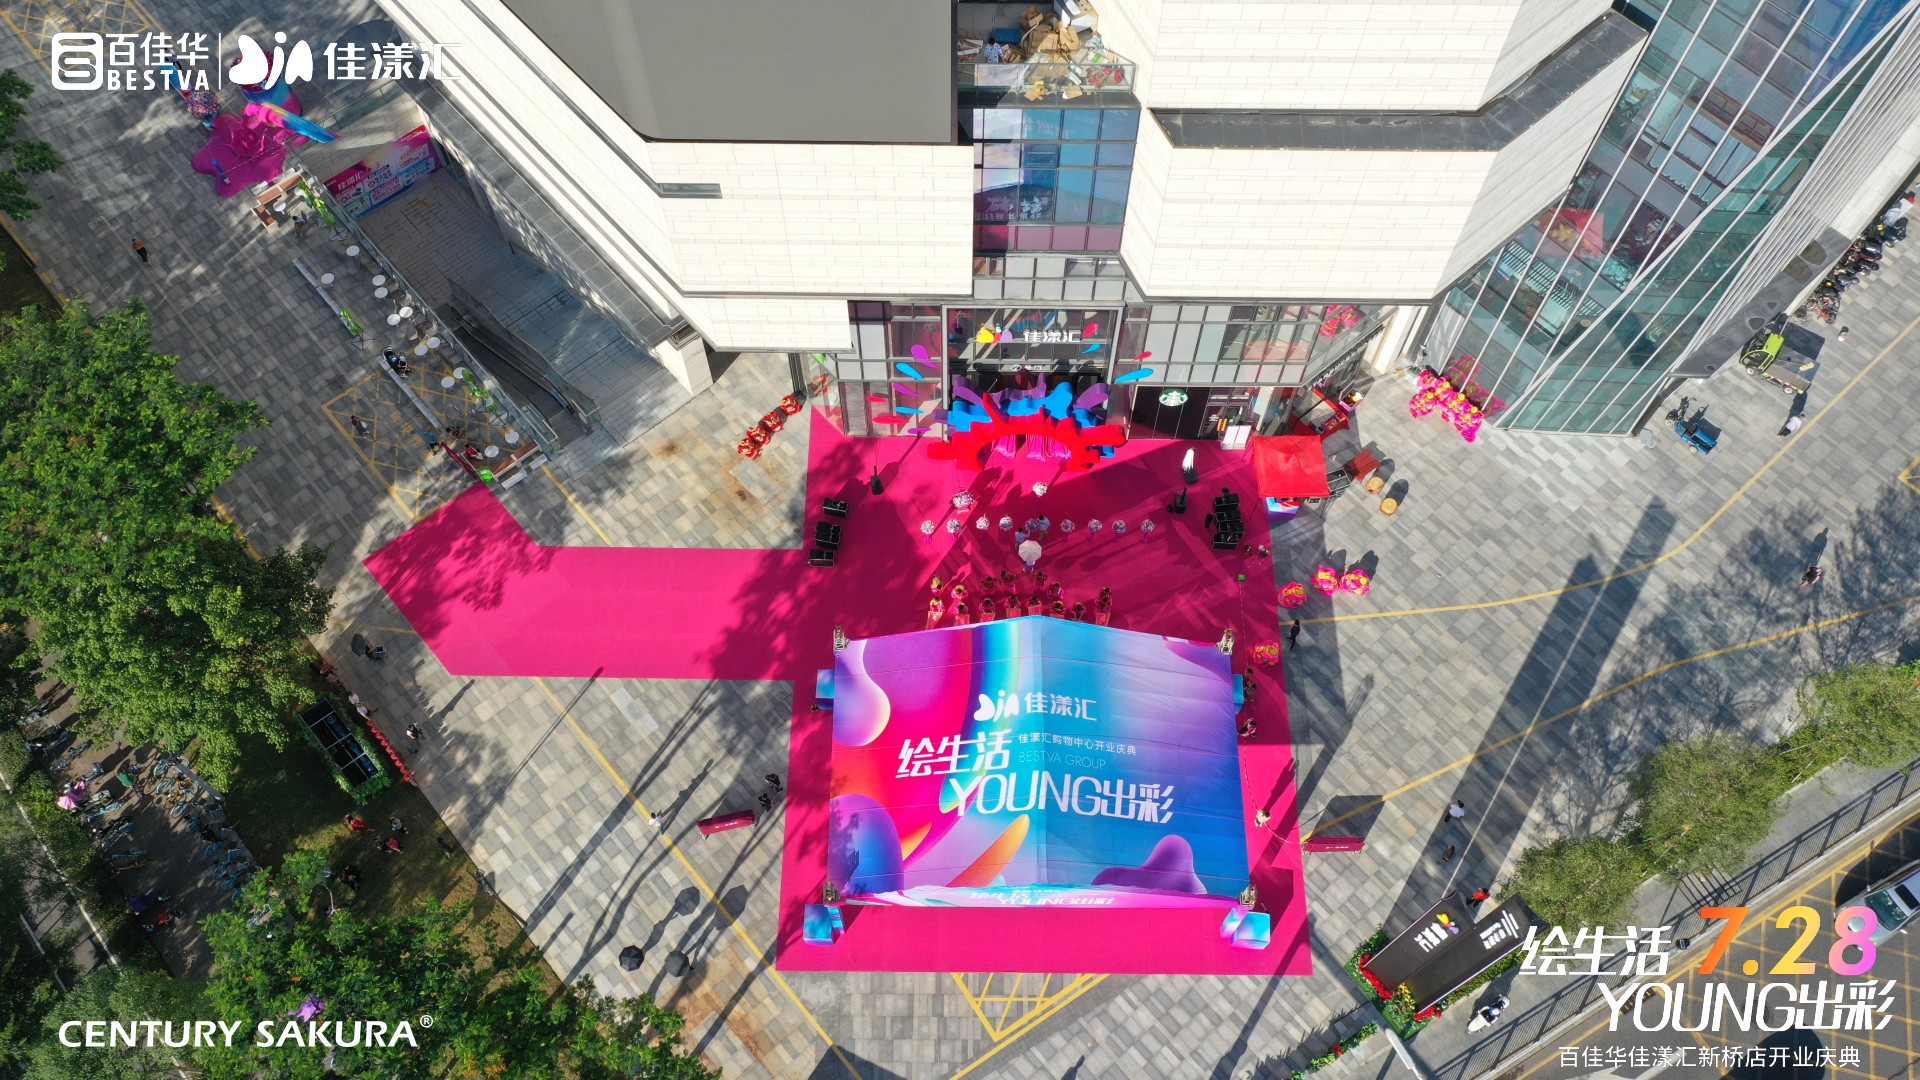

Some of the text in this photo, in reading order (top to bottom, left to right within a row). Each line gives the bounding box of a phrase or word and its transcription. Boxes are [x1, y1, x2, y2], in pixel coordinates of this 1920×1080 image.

[1023, 330, 1081, 342] 佳漾汇
[1024, 692, 1097, 721] 佳漾汇
[895, 729, 1012, 778] 绘生活
[1018, 732, 1137, 756] 佳漾汇购物中心开业庆典
[1019, 750, 1106, 769] BESTVA GROUP
